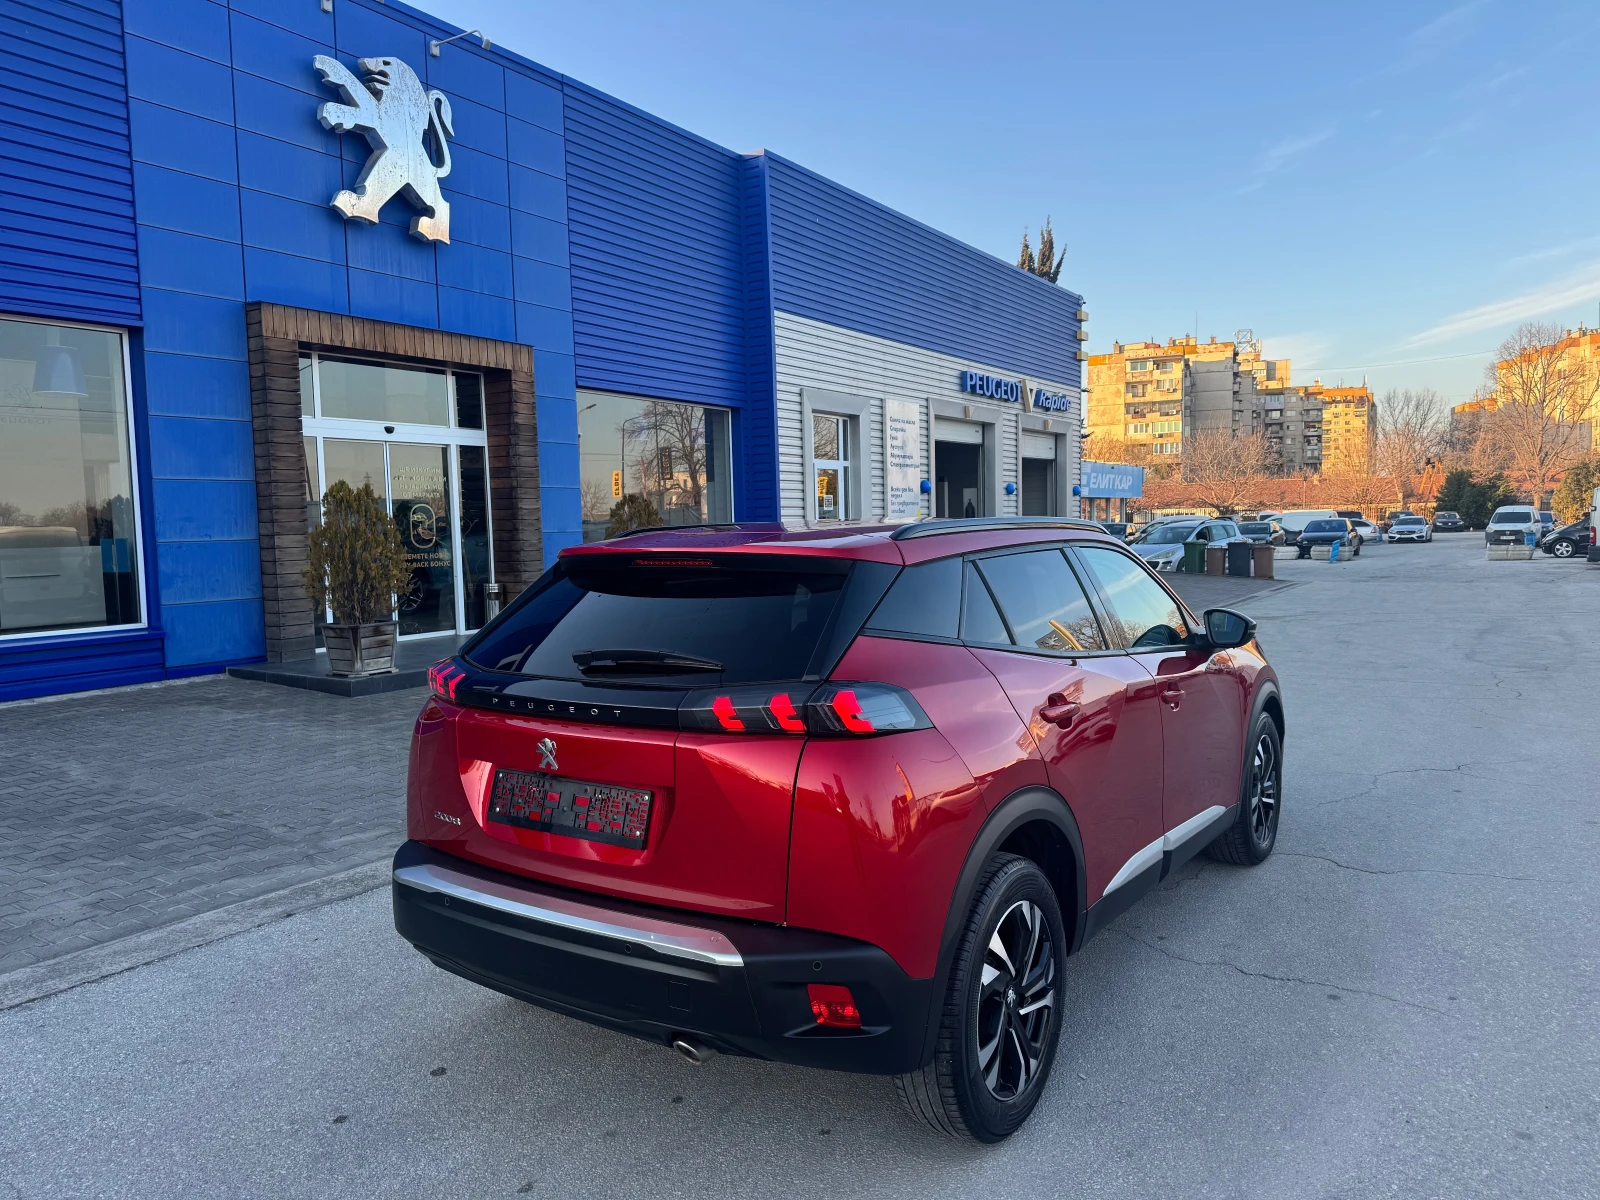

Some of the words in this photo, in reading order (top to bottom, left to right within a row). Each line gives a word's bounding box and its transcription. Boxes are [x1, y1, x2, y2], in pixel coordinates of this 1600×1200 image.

[966, 371, 1022, 402] PEUGEOT
[1039, 389, 1072, 412] Rapide
[0, 416, 51, 425] EUGEOT
[492, 698, 621, 718] PEUGEOT
[434, 810, 461, 826] 2008
